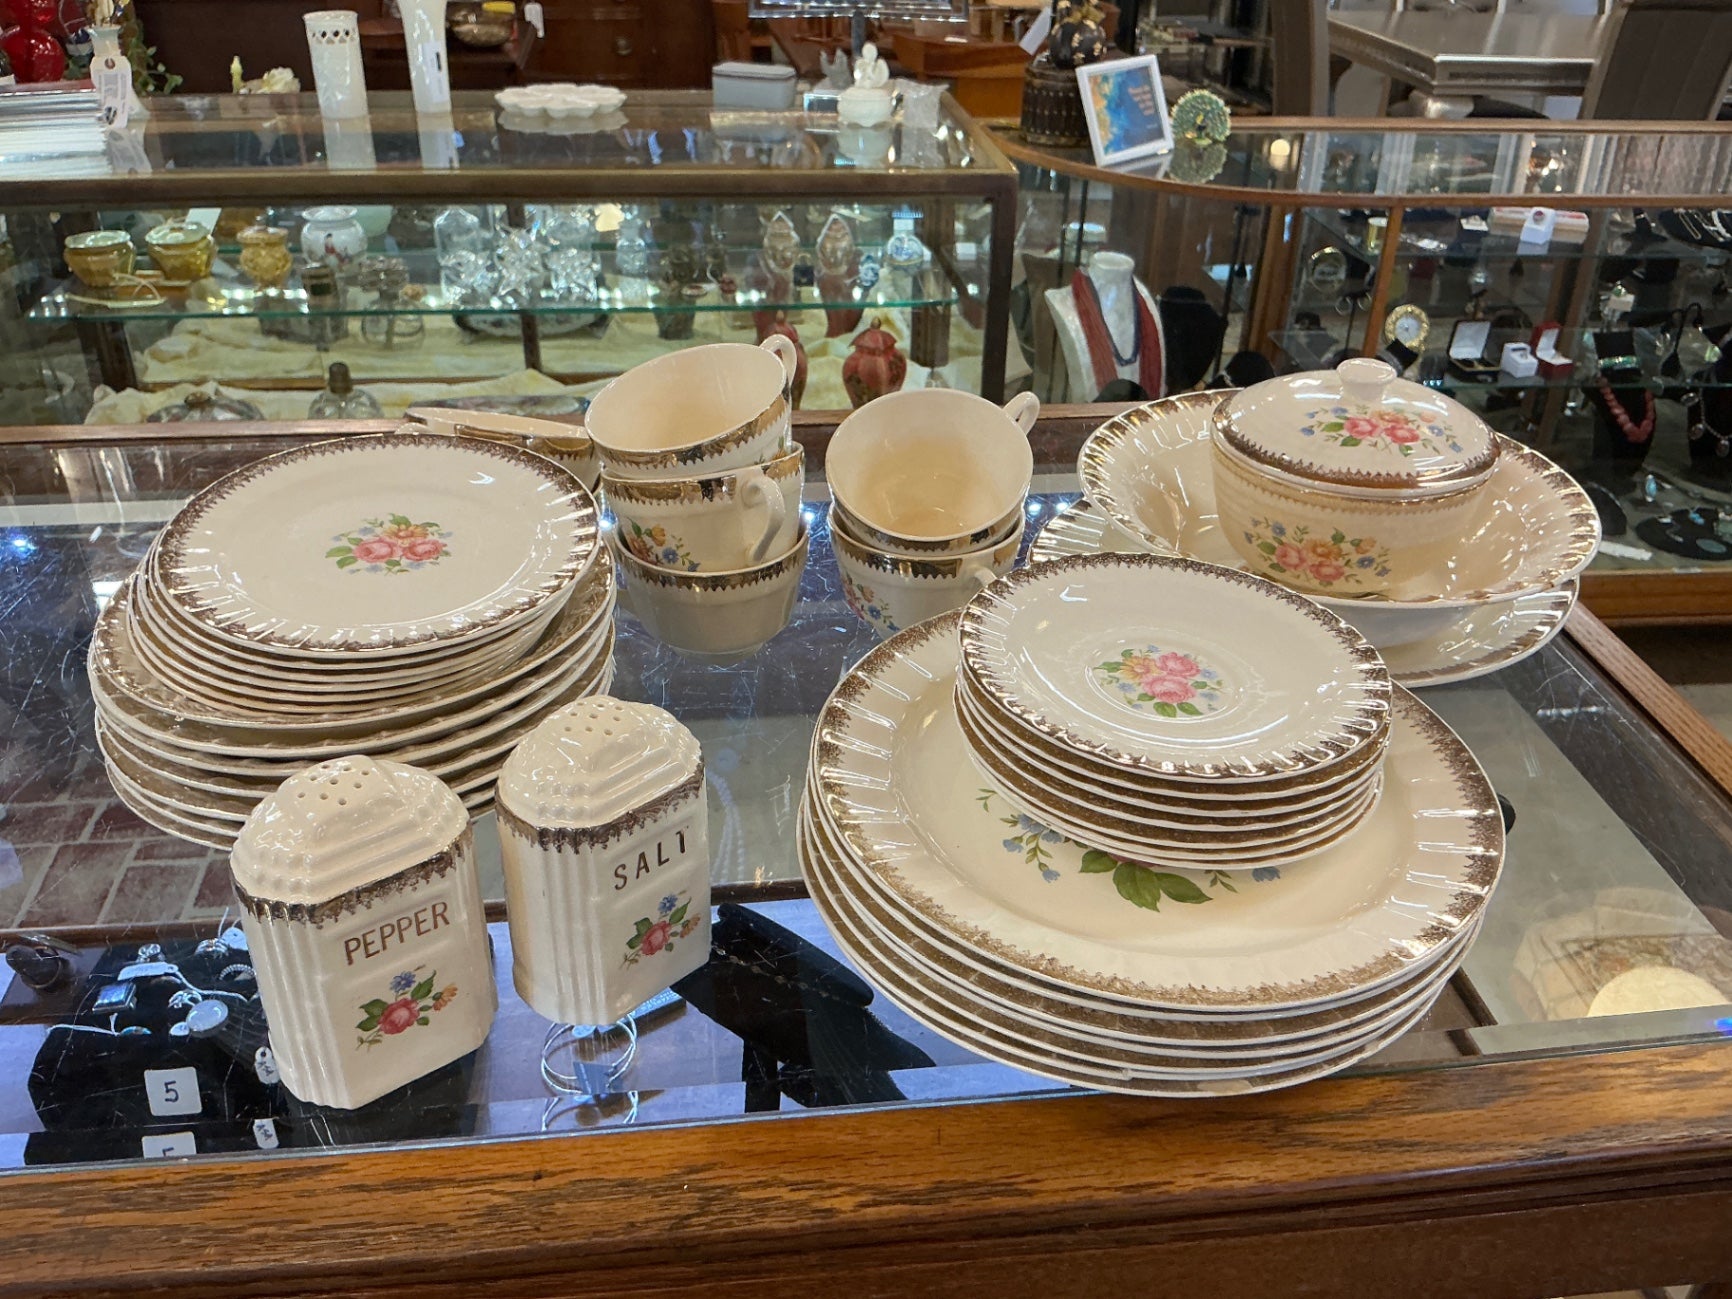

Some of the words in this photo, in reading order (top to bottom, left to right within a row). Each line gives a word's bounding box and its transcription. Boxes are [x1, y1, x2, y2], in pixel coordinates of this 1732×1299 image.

[614, 827, 689, 890] SALT
[344, 901, 450, 966] PEPPER
[164, 1080, 179, 1103] 5
